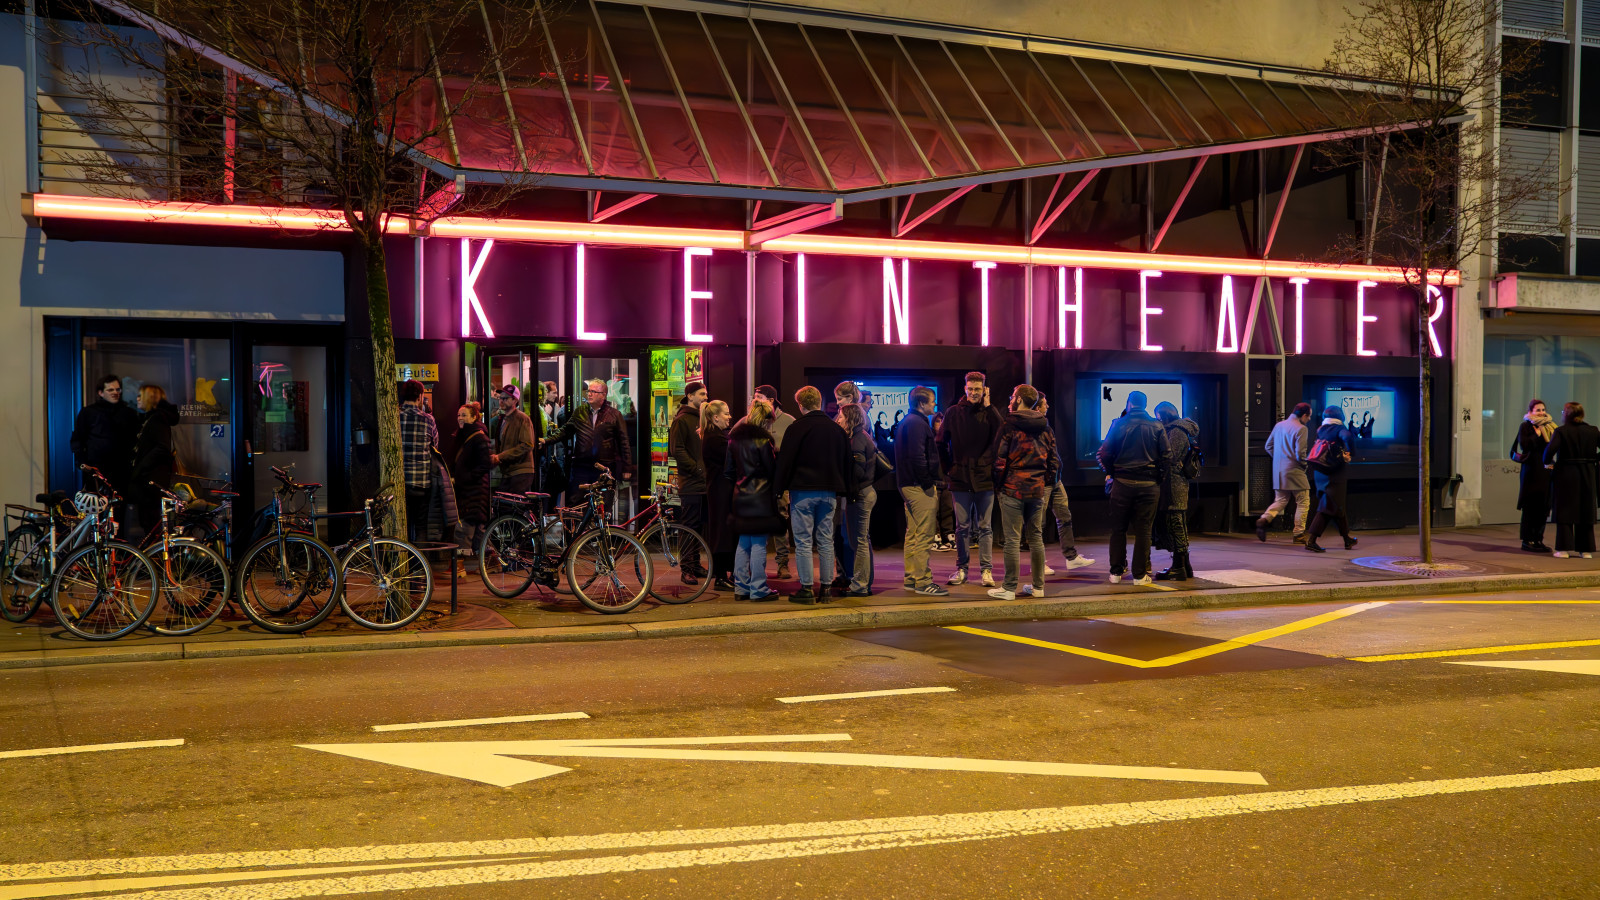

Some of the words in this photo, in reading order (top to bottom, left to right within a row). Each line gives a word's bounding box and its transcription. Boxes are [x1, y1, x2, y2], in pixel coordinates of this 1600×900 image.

[399, 367, 435, 378] Heute:
[195, 377, 217, 406] K
[1103, 386, 1112, 402] K
